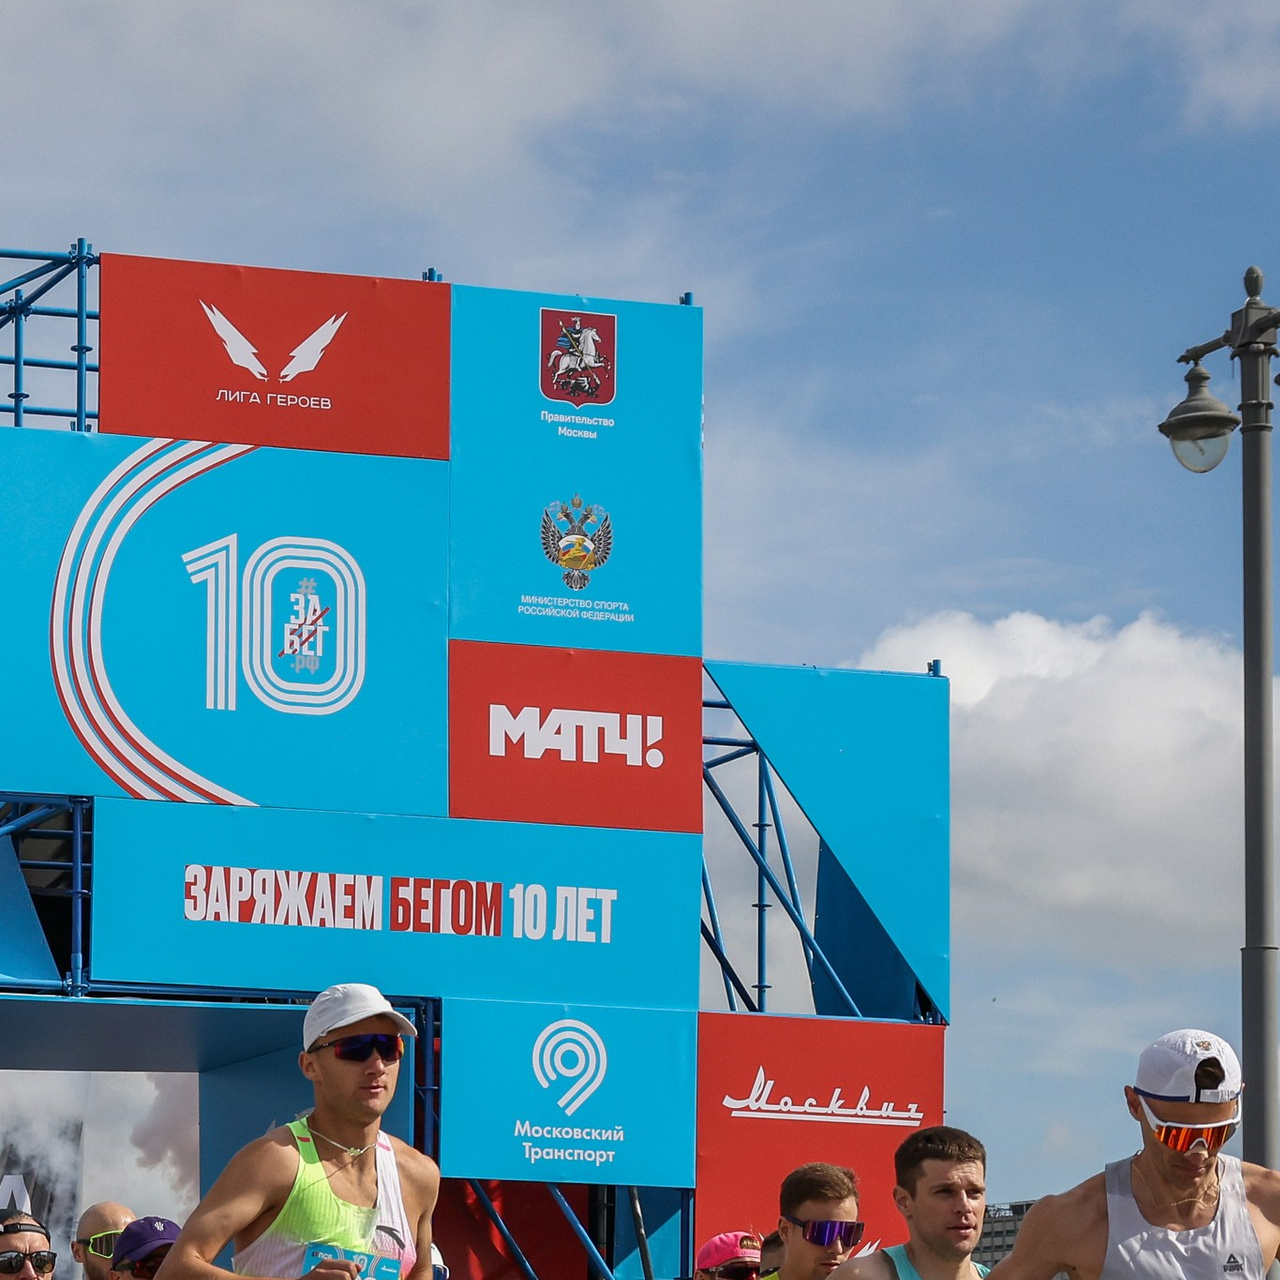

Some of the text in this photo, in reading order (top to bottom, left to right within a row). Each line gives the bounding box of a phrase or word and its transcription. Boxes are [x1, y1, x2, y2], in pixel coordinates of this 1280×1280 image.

[216, 389, 332, 410] ЛИГА ГЕРОЕВ
[540, 410, 615, 427] Правительство
[558, 426, 597, 439] Москвы
[518, 605, 634, 623] РОССИЙСКОЙ ФЕДЕРАЦИИ
[521, 595, 629, 611] МИНИСТЕРСТВО СПОРТА
[181, 532, 366, 716] 10
[489, 704, 664, 768] МАТЧ!
[184, 864, 618, 944] ЗАРЯЖАЕМ БЕГОМ 10 ЛЕТ
[514, 1119, 624, 1142] Московский
[522, 1142, 615, 1167] Транспорт
